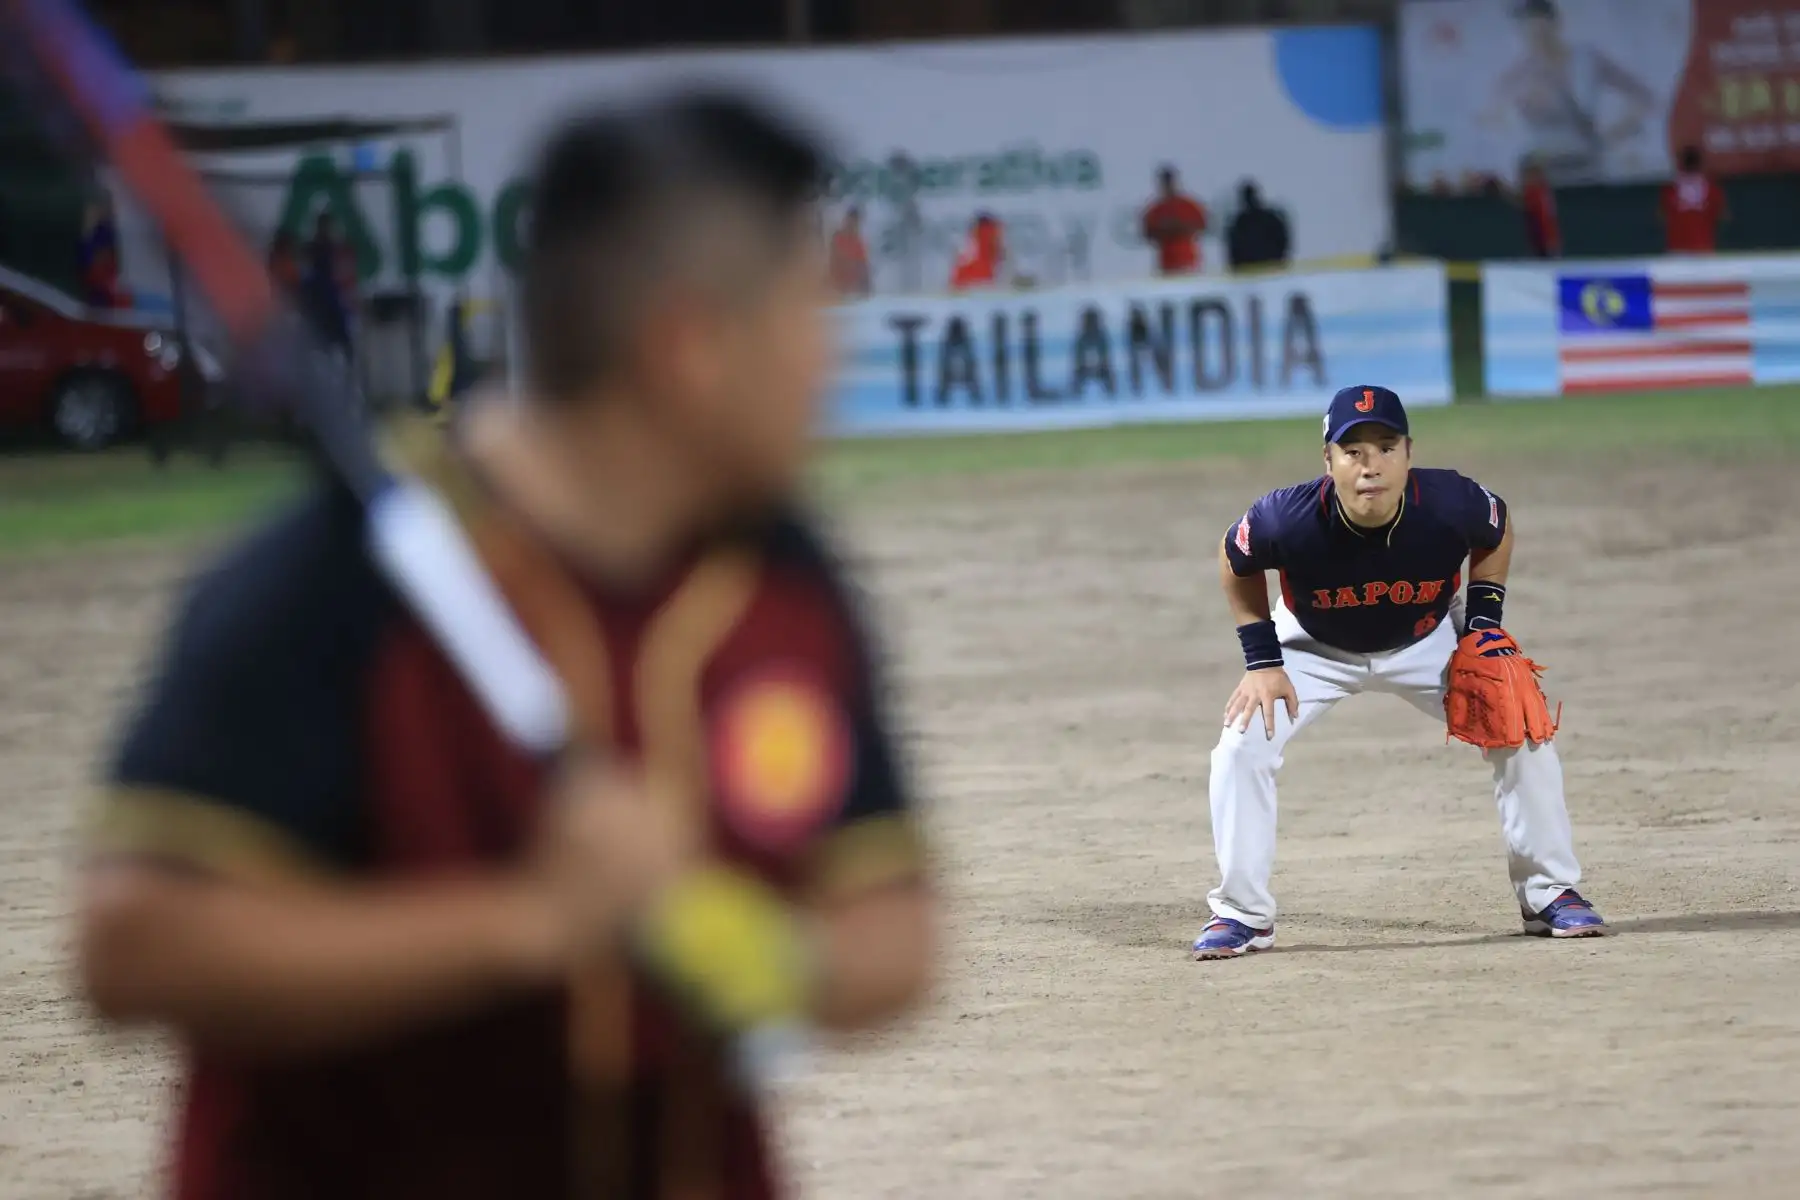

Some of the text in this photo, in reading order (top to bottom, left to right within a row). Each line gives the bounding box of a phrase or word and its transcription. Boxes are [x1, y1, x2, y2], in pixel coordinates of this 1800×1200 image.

[888, 291, 1326, 408] TAILANDIA
[1355, 390, 1374, 413] J
[1312, 579, 1446, 609] JAPON
[1413, 611, 1437, 637] 6
